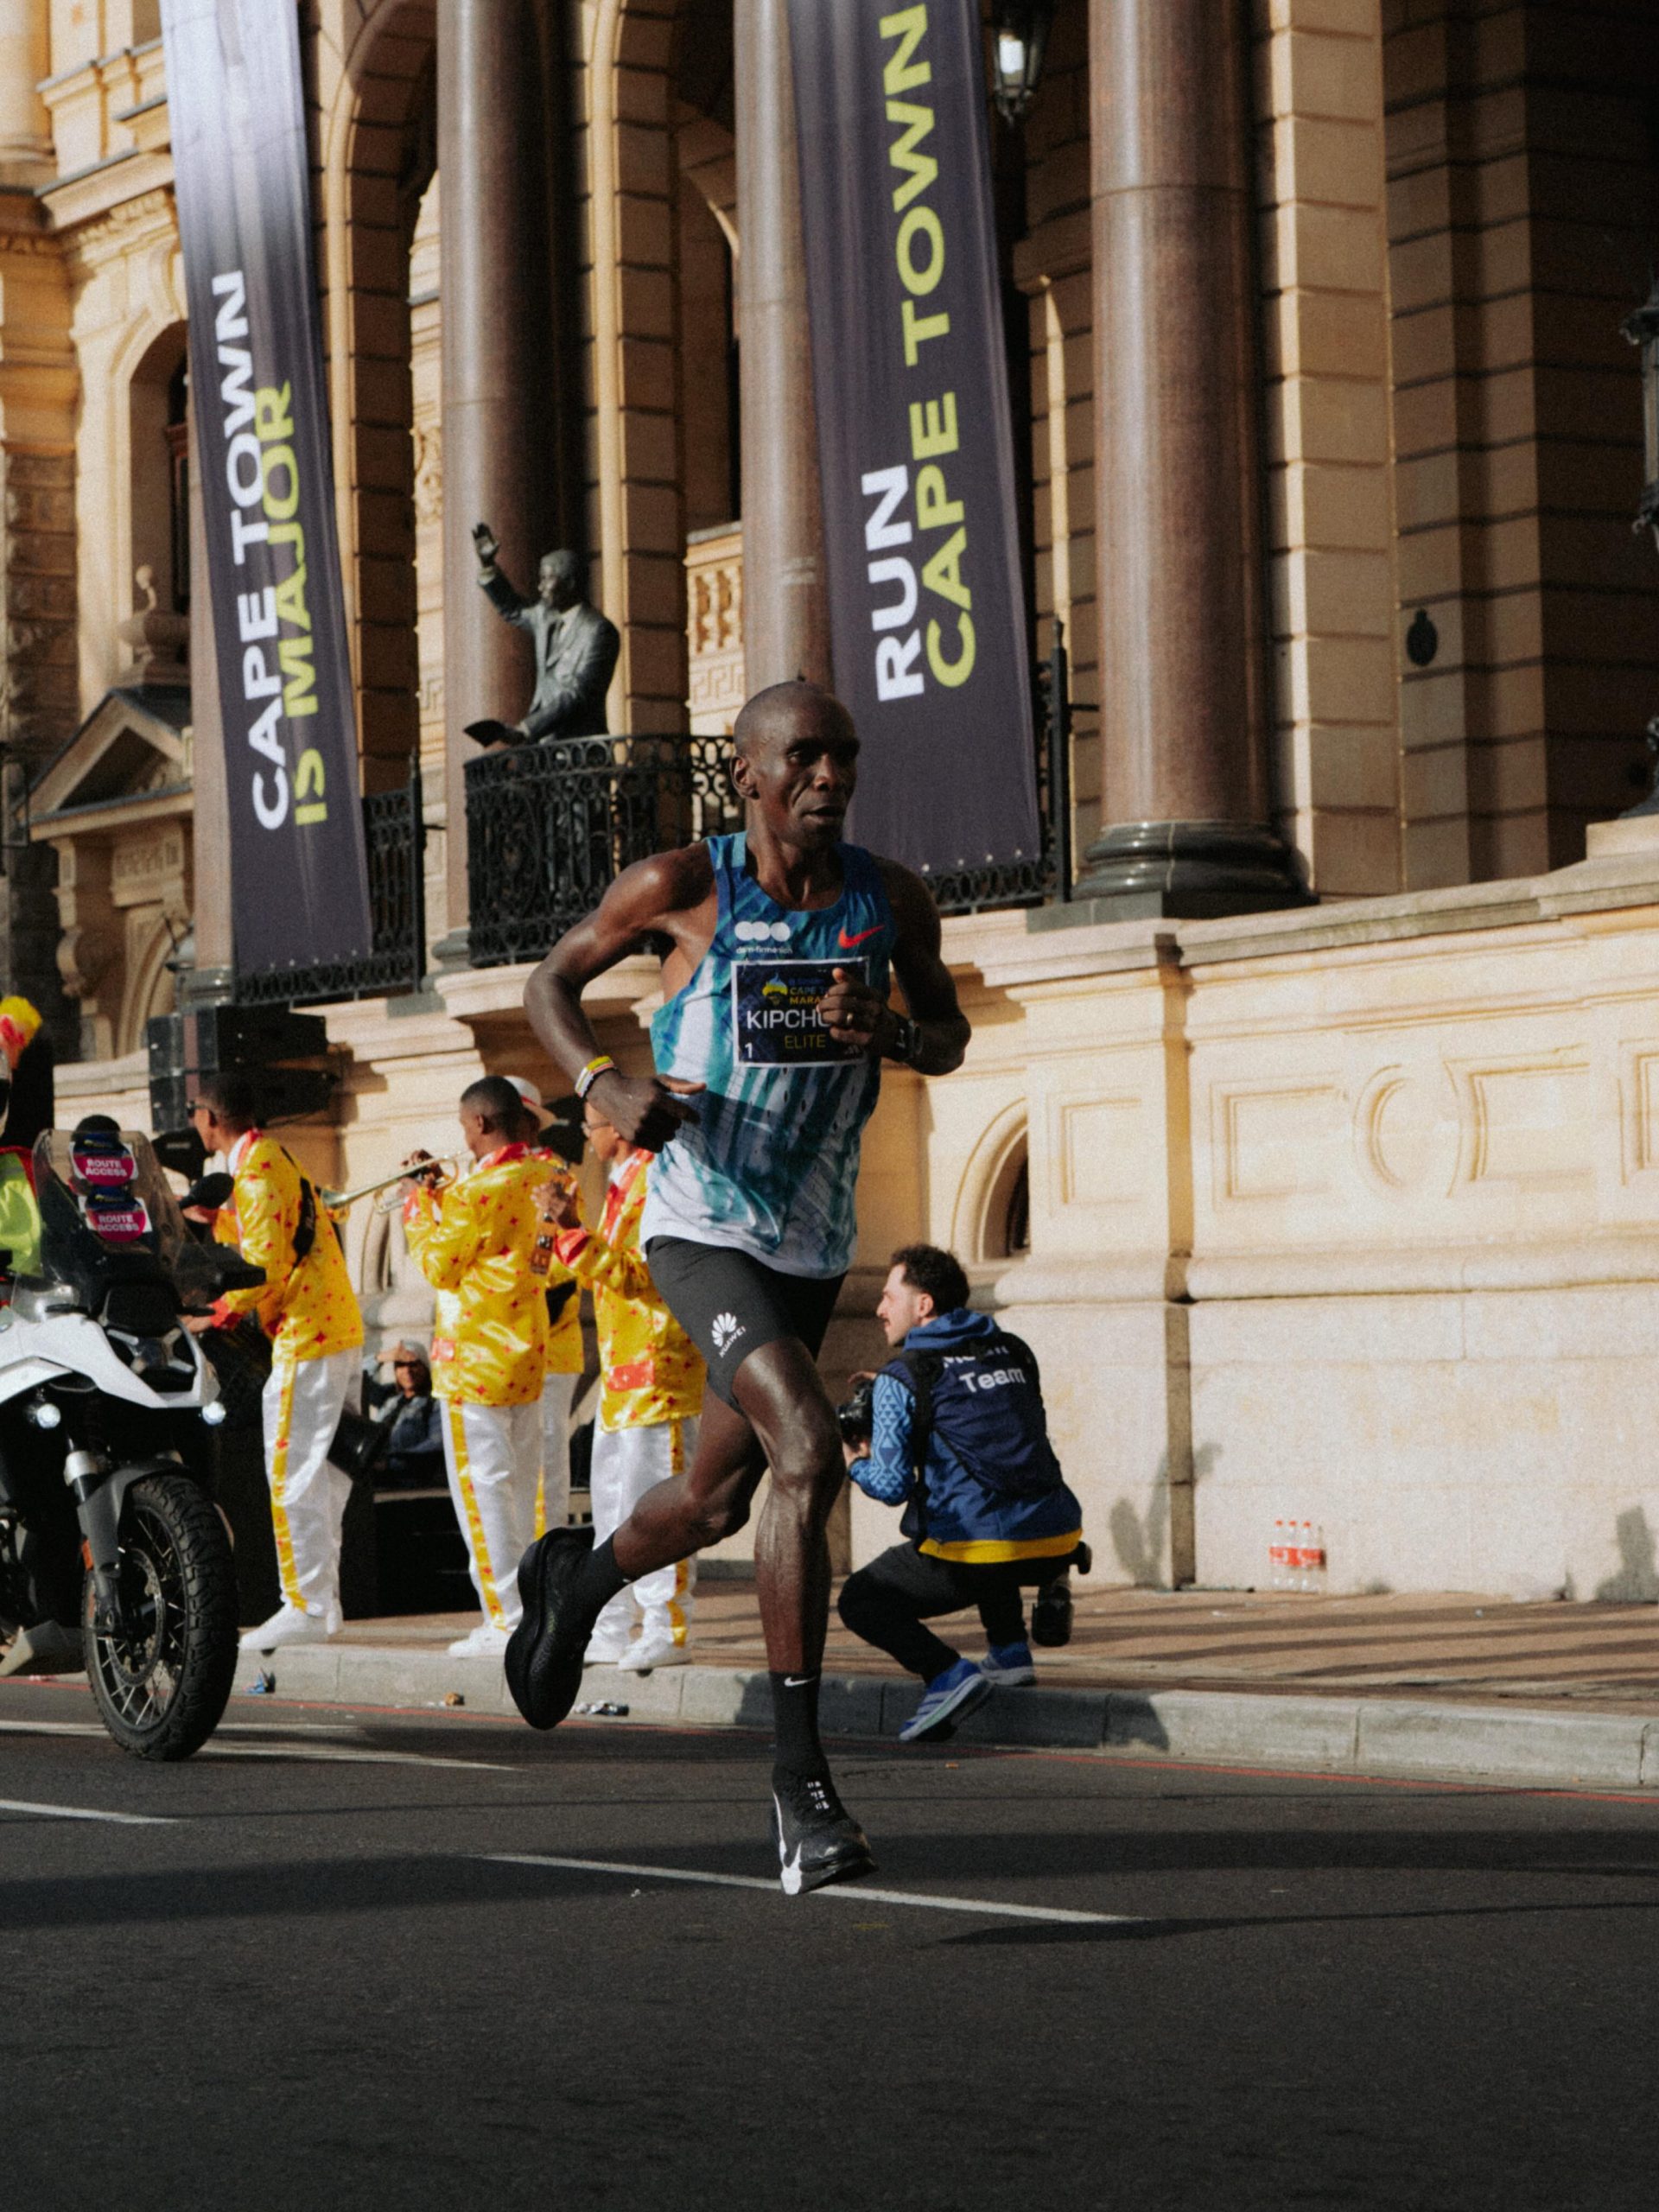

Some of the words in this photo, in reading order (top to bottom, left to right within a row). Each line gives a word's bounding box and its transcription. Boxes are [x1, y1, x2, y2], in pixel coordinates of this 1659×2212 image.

[879, 3, 950, 366] TOWN
[212, 270, 270, 566] TOWN
[254, 380, 320, 719] MAJOR
[909, 391, 976, 689] CAPE
[861, 464, 925, 702] RUN
[238, 585, 289, 830] CAPE
[295, 747, 327, 825] IS
[790, 995, 821, 1005] MARA
[744, 1042, 753, 1059] 1
[784, 1034, 826, 1049] ELITE
[85, 1166, 128, 1177] ACCESS
[86, 1159, 121, 1168] ROUTE
[98, 1223, 139, 1232] ACCESS
[99, 1214, 133, 1224] ROUTE
[718, 1325, 747, 1358] HUAWEI
[958, 1368, 1027, 1393] Team
